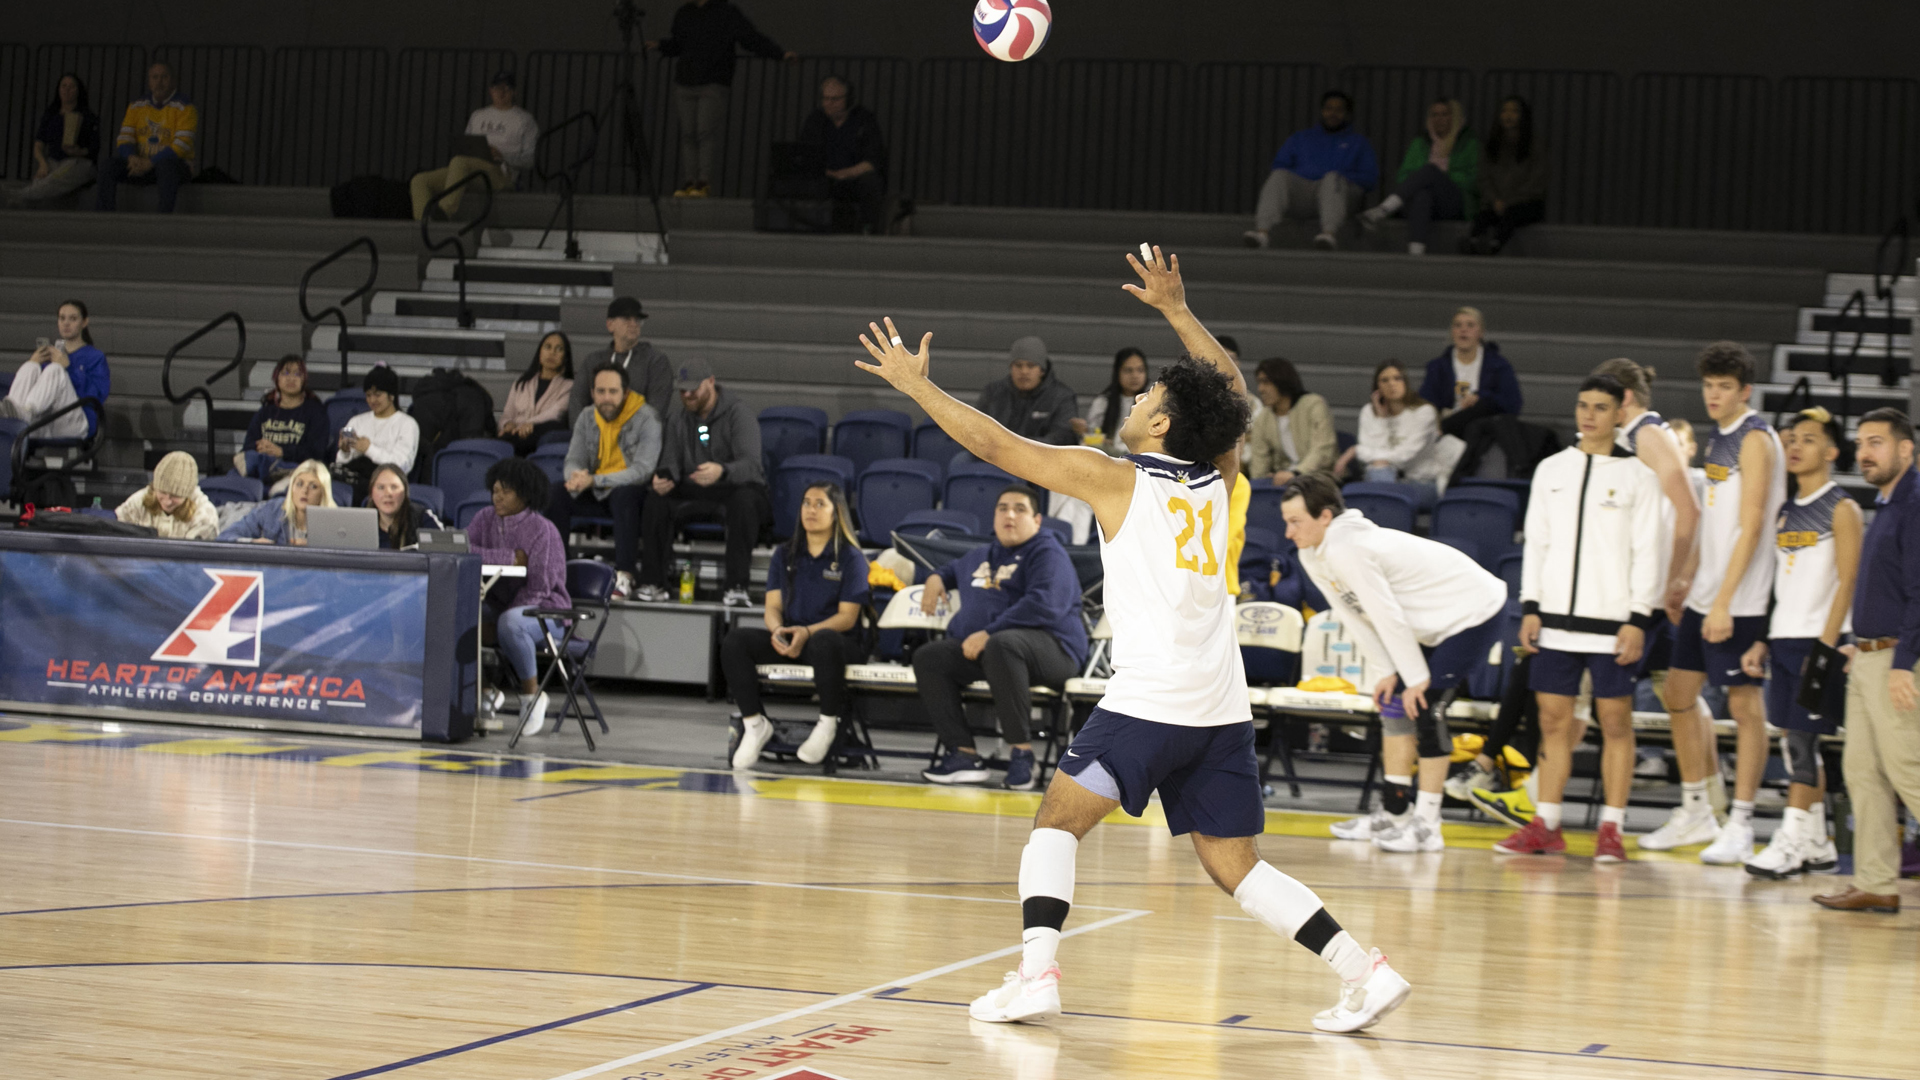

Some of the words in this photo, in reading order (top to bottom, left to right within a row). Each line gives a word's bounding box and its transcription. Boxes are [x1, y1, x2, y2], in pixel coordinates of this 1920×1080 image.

[1167, 496, 1219, 576] 21
[46, 658, 160, 685] HEART
[166, 666, 201, 683] OF
[203, 669, 366, 700] AMERICA
[88, 684, 178, 701] ATHLETIC
[189, 691, 321, 711] CONFERENCE
[668, 1035, 785, 1069] ATHLETIC
[737, 1024, 894, 1068] HEART
